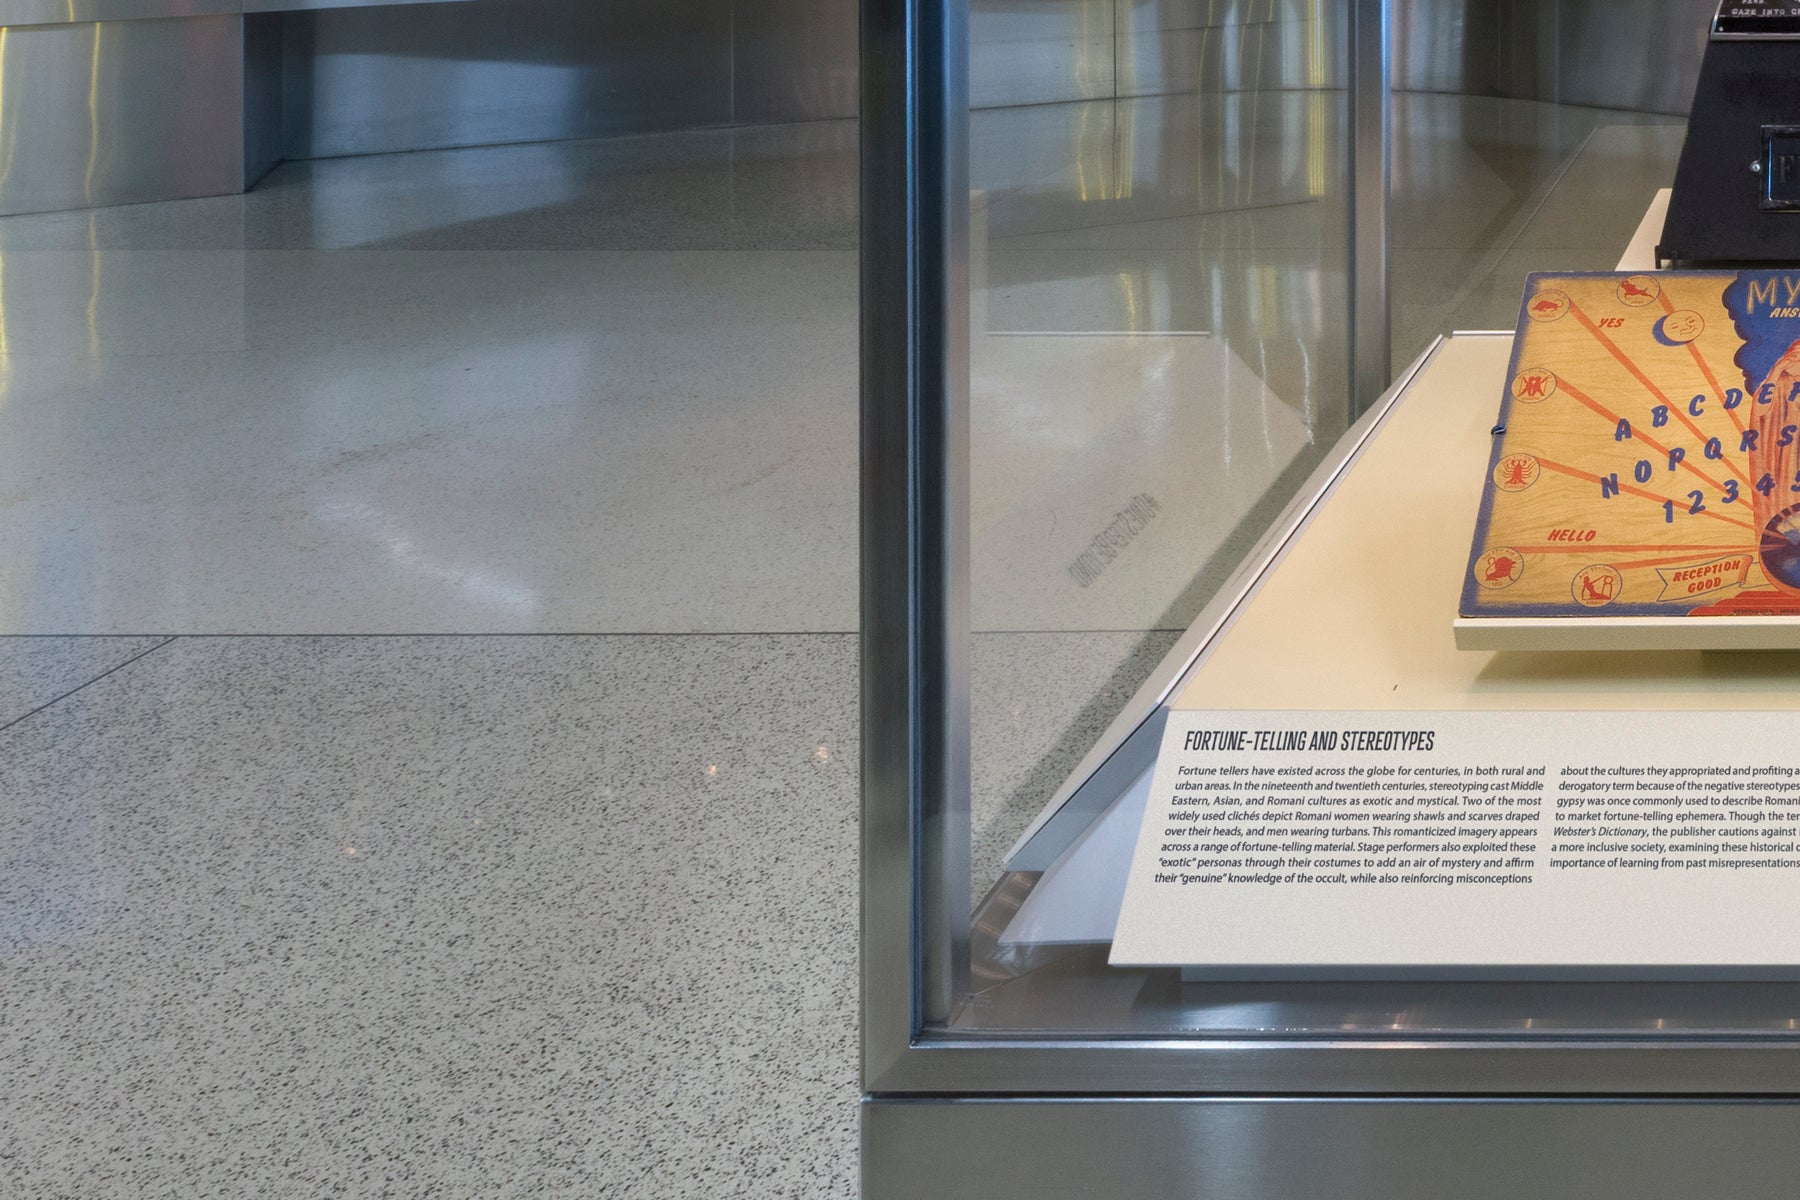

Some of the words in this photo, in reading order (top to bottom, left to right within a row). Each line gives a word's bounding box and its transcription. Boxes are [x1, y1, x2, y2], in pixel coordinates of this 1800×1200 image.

[1731, 8, 1757, 16] GAZE
[1762, 8, 1786, 16] INTO
[1598, 317, 1625, 329] YES
[1614, 418, 1632, 442] A
[1651, 405, 1668, 428] B
[1689, 394, 1706, 416] C
[1723, 388, 1743, 410] D
[1757, 383, 1775, 405] E
[1600, 473, 1619, 499] N
[1634, 460, 1652, 483] O
[1668, 447, 1686, 471] P
[1704, 437, 1723, 460] Q
[1739, 429, 1759, 452] R
[1777, 424, 1797, 447] S
[1662, 500, 1673, 523] 1
[1687, 490, 1706, 515] 2
[1721, 480, 1739, 504] 3
[1756, 472, 1776, 496] 4
[1547, 529, 1597, 542] HELLO
[1672, 559, 1742, 583] RECEPTION
[1687, 577, 1722, 593] GOOD
[1184, 730, 1307, 752] FORTUNE-TELLING
[1308, 730, 1338, 752] AND
[1340, 730, 1435, 752] STEREOTYPES
[1178, 766, 1217, 776] Fortune
[1219, 765, 1249, 776] tellers
[1251, 766, 1276, 776] have
[1277, 766, 1314, 776] existed
[1314, 768, 1346, 776] across
[1348, 766, 1365, 776] the
[1366, 766, 1396, 778] globe
[1397, 765, 1412, 776] for
[1413, 766, 1461, 777] centuries,
[1463, 766, 1473, 776] in
[1475, 765, 1499, 776] both
[1501, 766, 1525, 776] rural
[1526, 765, 1546, 776] and
[1555, 812, 1566, 821] to
[1567, 811, 1602, 821] market
[1603, 810, 1673, 823] fortune-telling
[1675, 811, 1727, 823] ephemera.
[1728, 811, 1766, 823] Though
[1768, 811, 1785, 821] the
